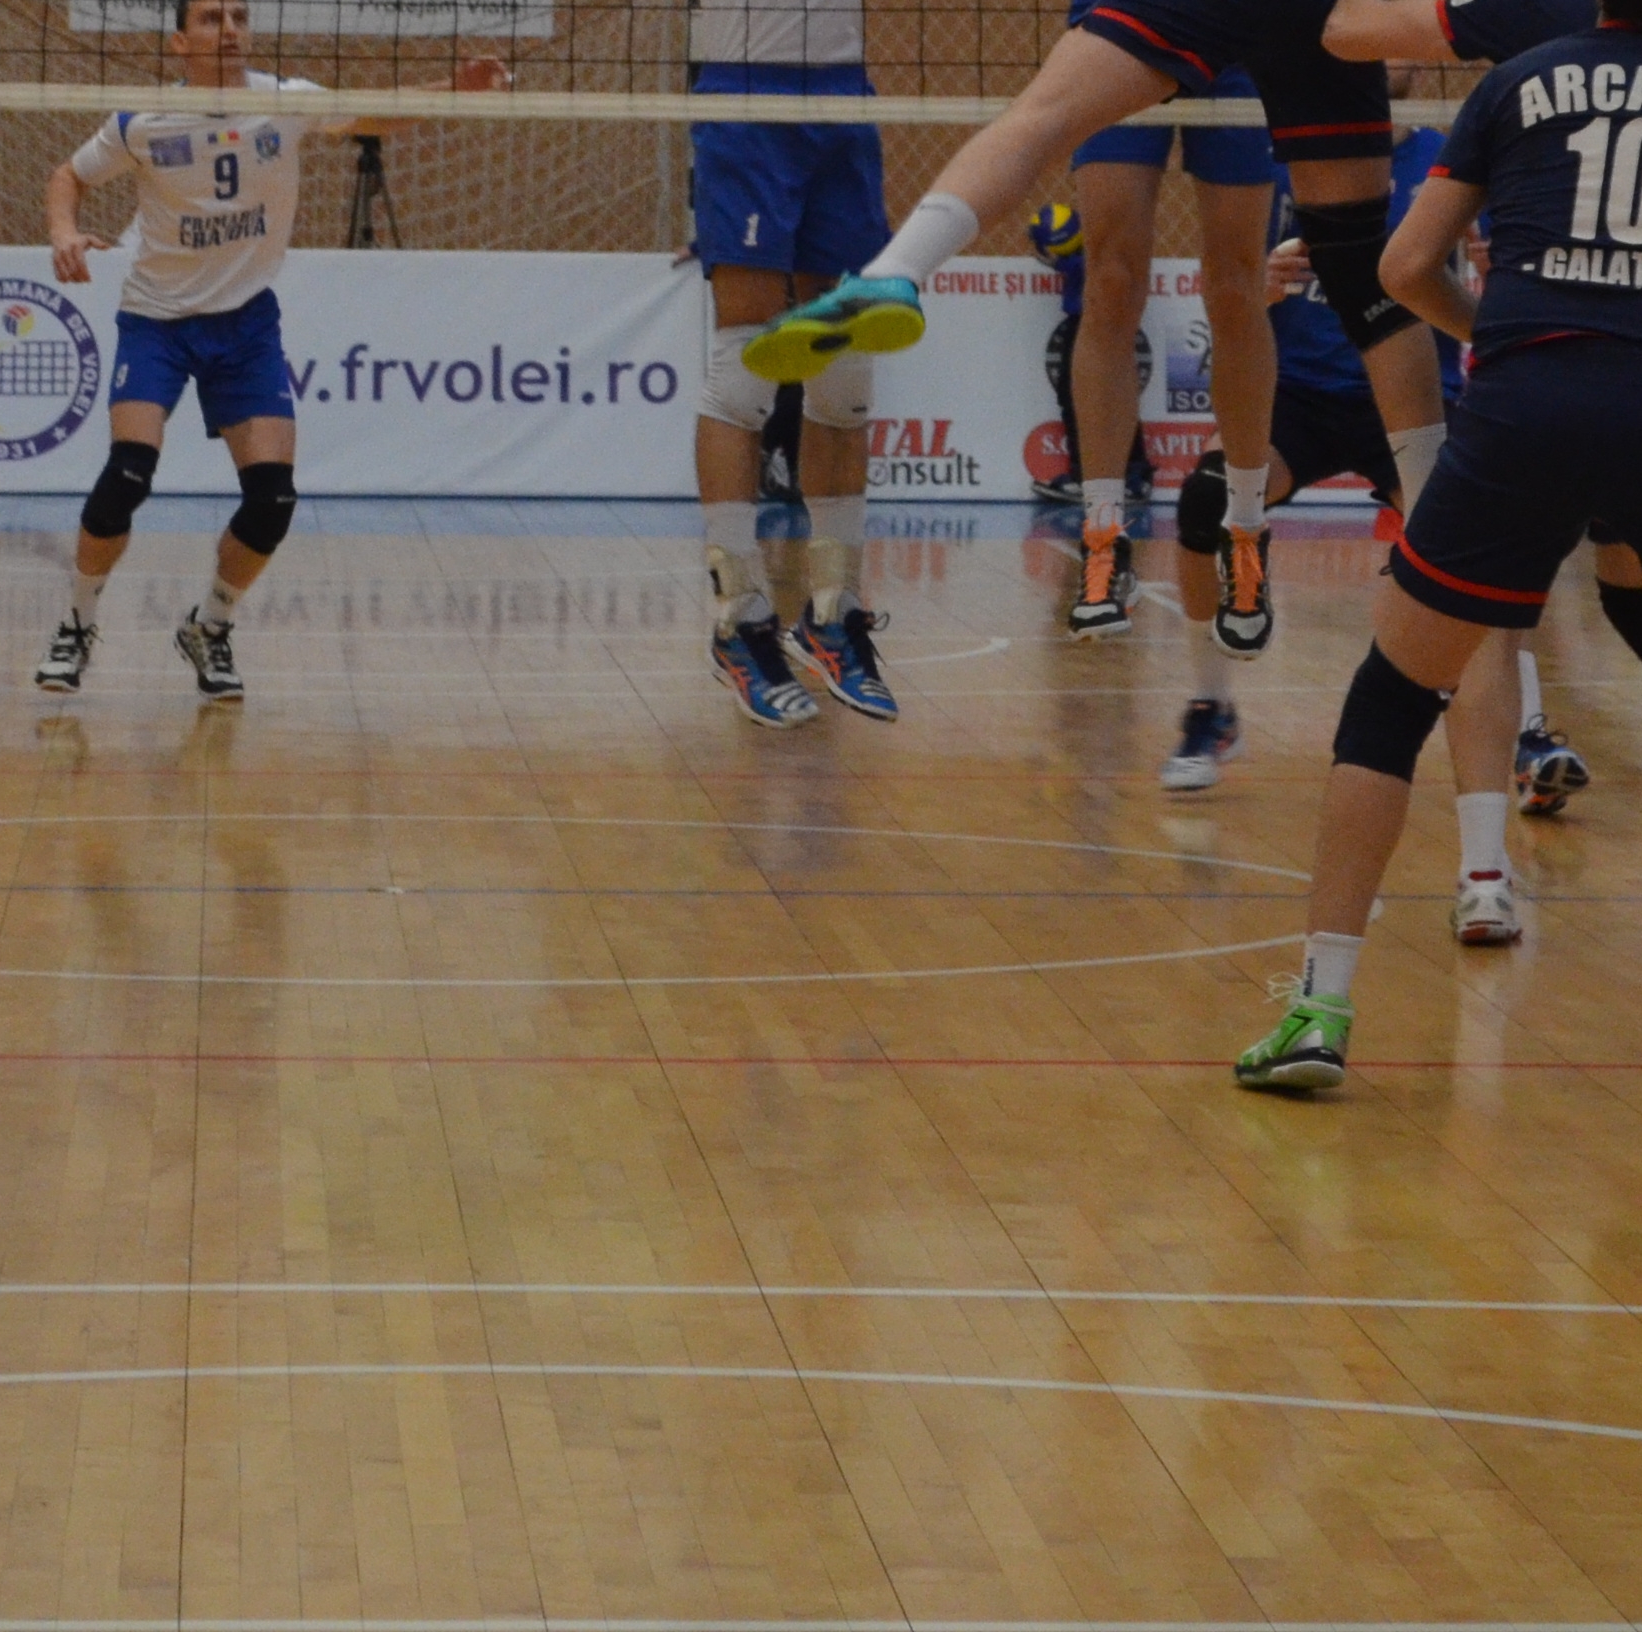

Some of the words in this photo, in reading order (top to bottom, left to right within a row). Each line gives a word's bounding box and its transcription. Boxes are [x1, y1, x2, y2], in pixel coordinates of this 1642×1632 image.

[213, 151, 240, 201] 9
[933, 271, 998, 296] CIVILE
[66, 313, 92, 343] DE
[71, 351, 98, 418] VOLEI
